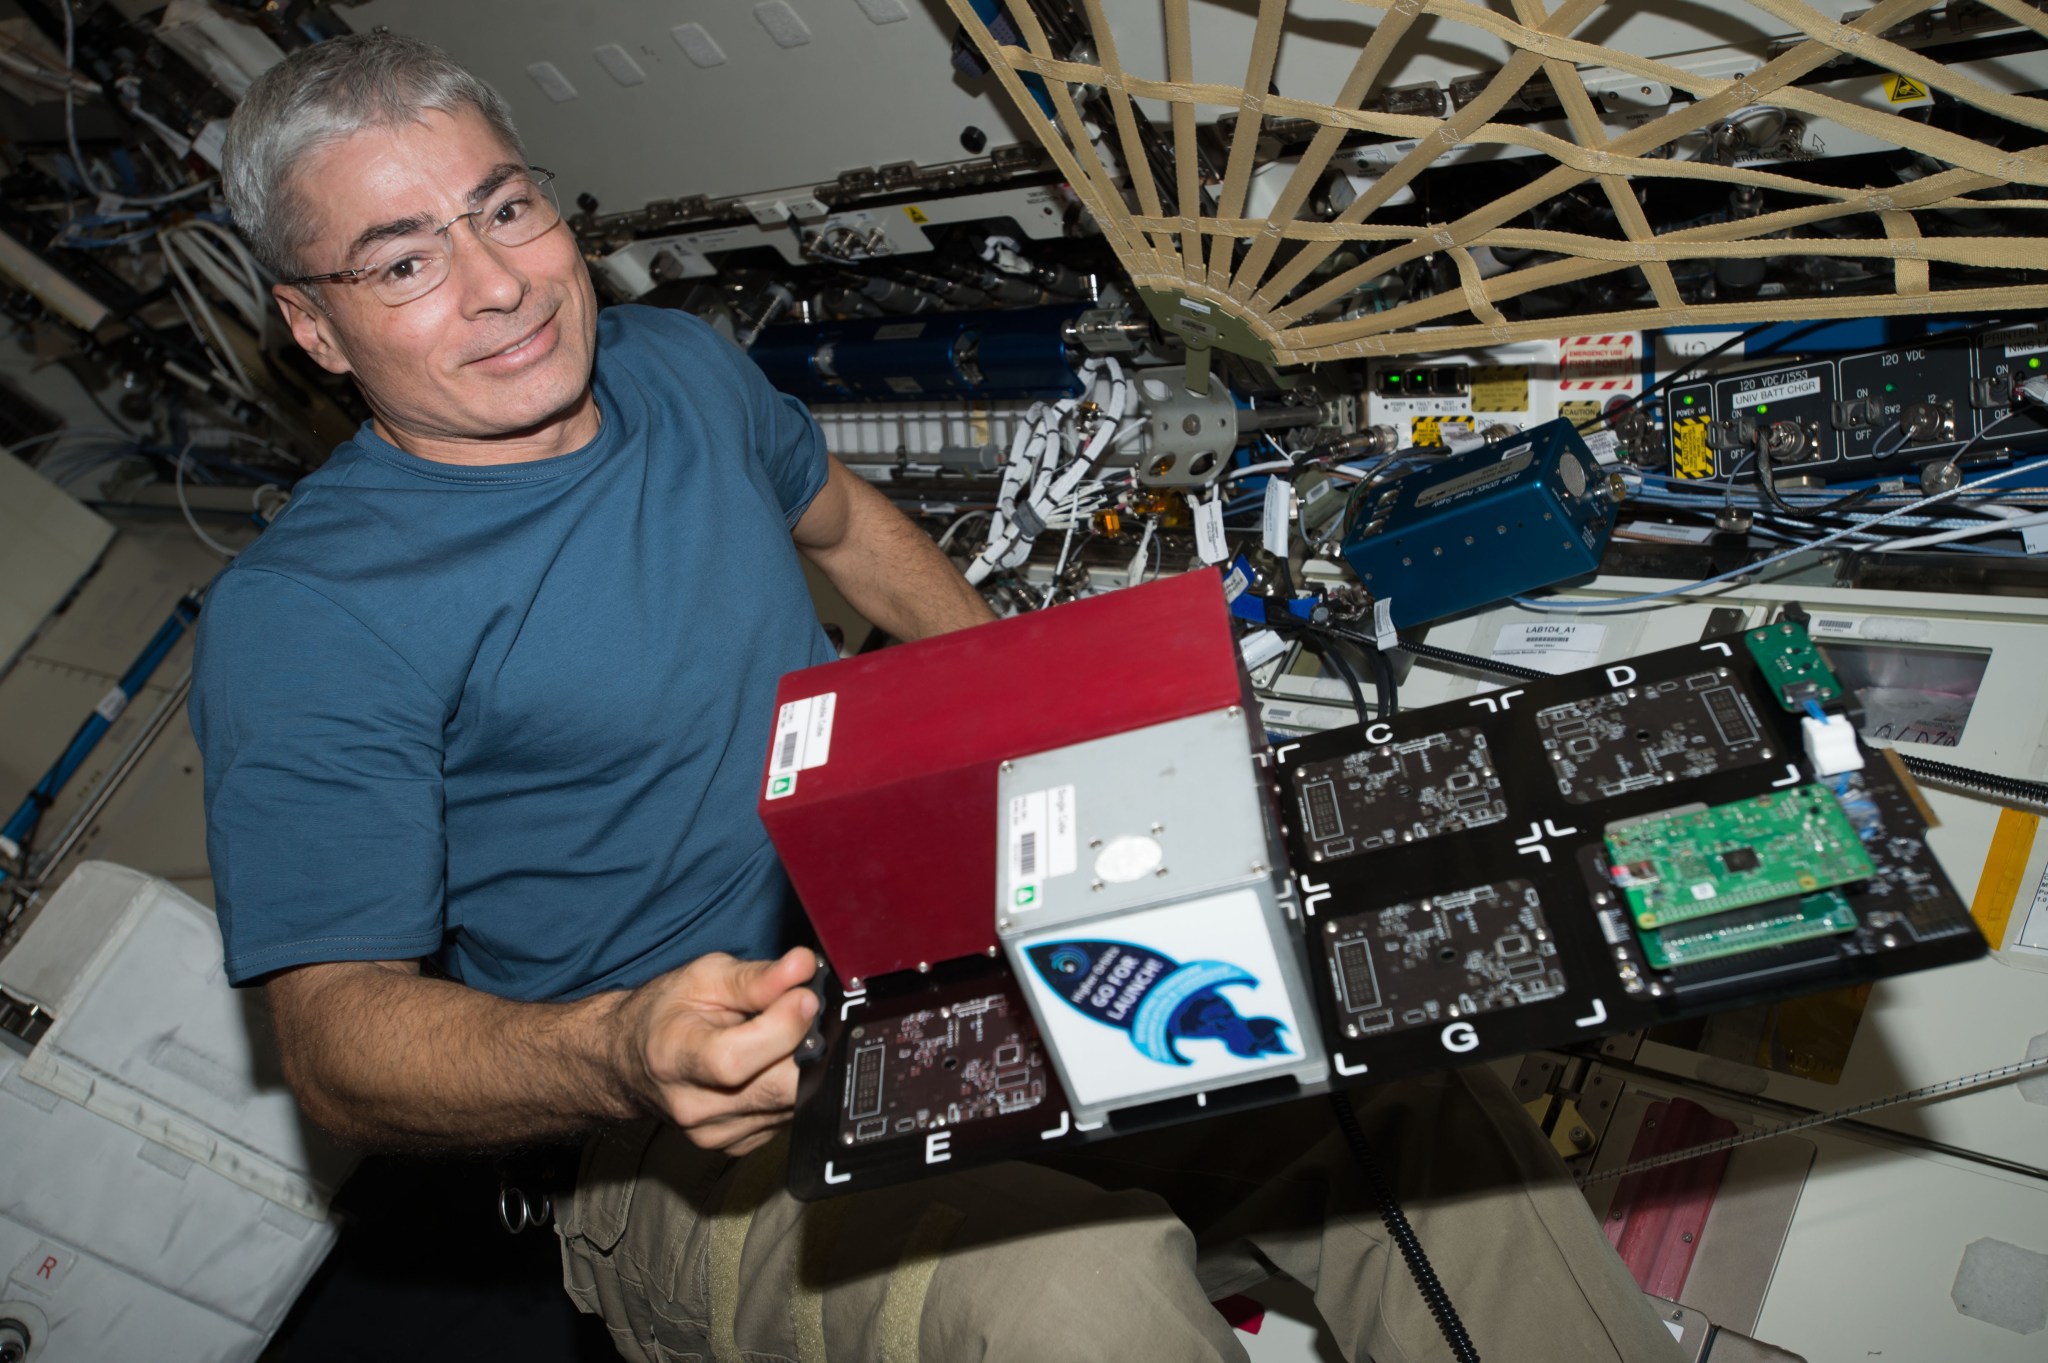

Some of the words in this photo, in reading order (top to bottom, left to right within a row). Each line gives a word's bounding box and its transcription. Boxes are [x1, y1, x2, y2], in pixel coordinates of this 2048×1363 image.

[1569, 360, 1592, 369] FIRE
[1594, 359, 1624, 368] PORT
[1882, 353, 1899, 367] 120
[1906, 350, 1926, 363] VDC
[1995, 364, 2009, 375] ON
[1740, 379, 1755, 392] 120
[1761, 369, 1809, 388] VDC/1553
[1735, 391, 1760, 405] UNIV
[1760, 386, 1787, 401] BATT
[1787, 379, 1817, 395] CHGR
[1856, 388, 1869, 399] ON
[1564, 408, 1597, 416] CAUTION
[1676, 407, 1695, 417] POWER
[1731, 410, 1743, 420] ON
[1884, 406, 1901, 415] SW2
[1994, 408, 2012, 419] OFF
[1855, 429, 1872, 441] OFF
[1682, 432, 1690, 467] CAUTION
[1731, 449, 1746, 460] OFF
[1453, 488, 1474, 502] Power
[1525, 626, 1576, 635] LAB1D4_A1
[1606, 666, 1636, 687] D
[1365, 723, 1393, 744] C
[1091, 984, 1116, 1008] GO
[1106, 955, 1139, 987] FOR
[1106, 957, 1164, 1020] LAUNCH!
[1442, 1022, 1479, 1053] G
[926, 1131, 952, 1164] E
[36, 1255, 58, 1281] R
